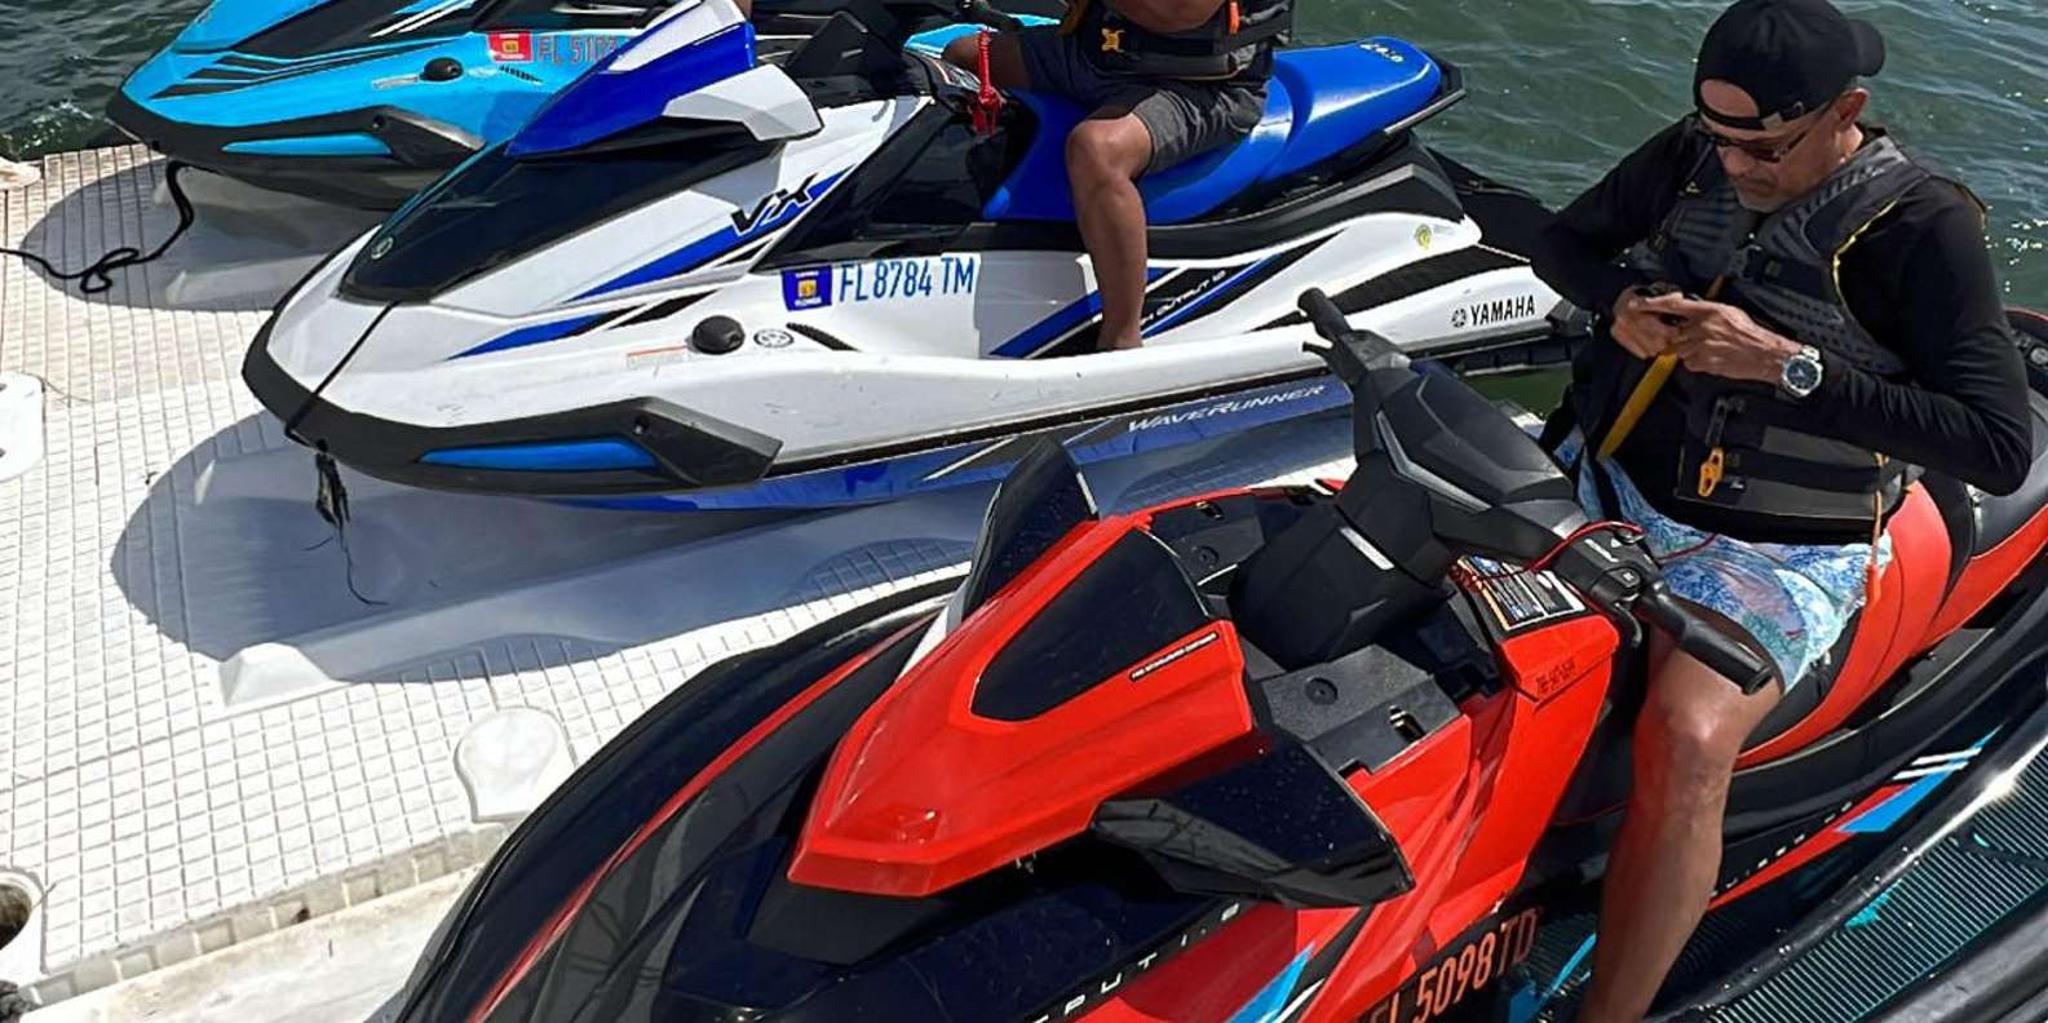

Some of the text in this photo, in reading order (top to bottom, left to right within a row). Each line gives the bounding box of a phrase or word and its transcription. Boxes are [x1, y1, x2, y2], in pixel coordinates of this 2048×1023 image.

[731, 172, 822, 234] VX
[839, 255, 975, 302] FL 8784 TM
[1470, 294, 1536, 326] YAMAHA
[1127, 384, 1325, 432] WAVERUNNER
[1411, 930, 1497, 1023] 5098
